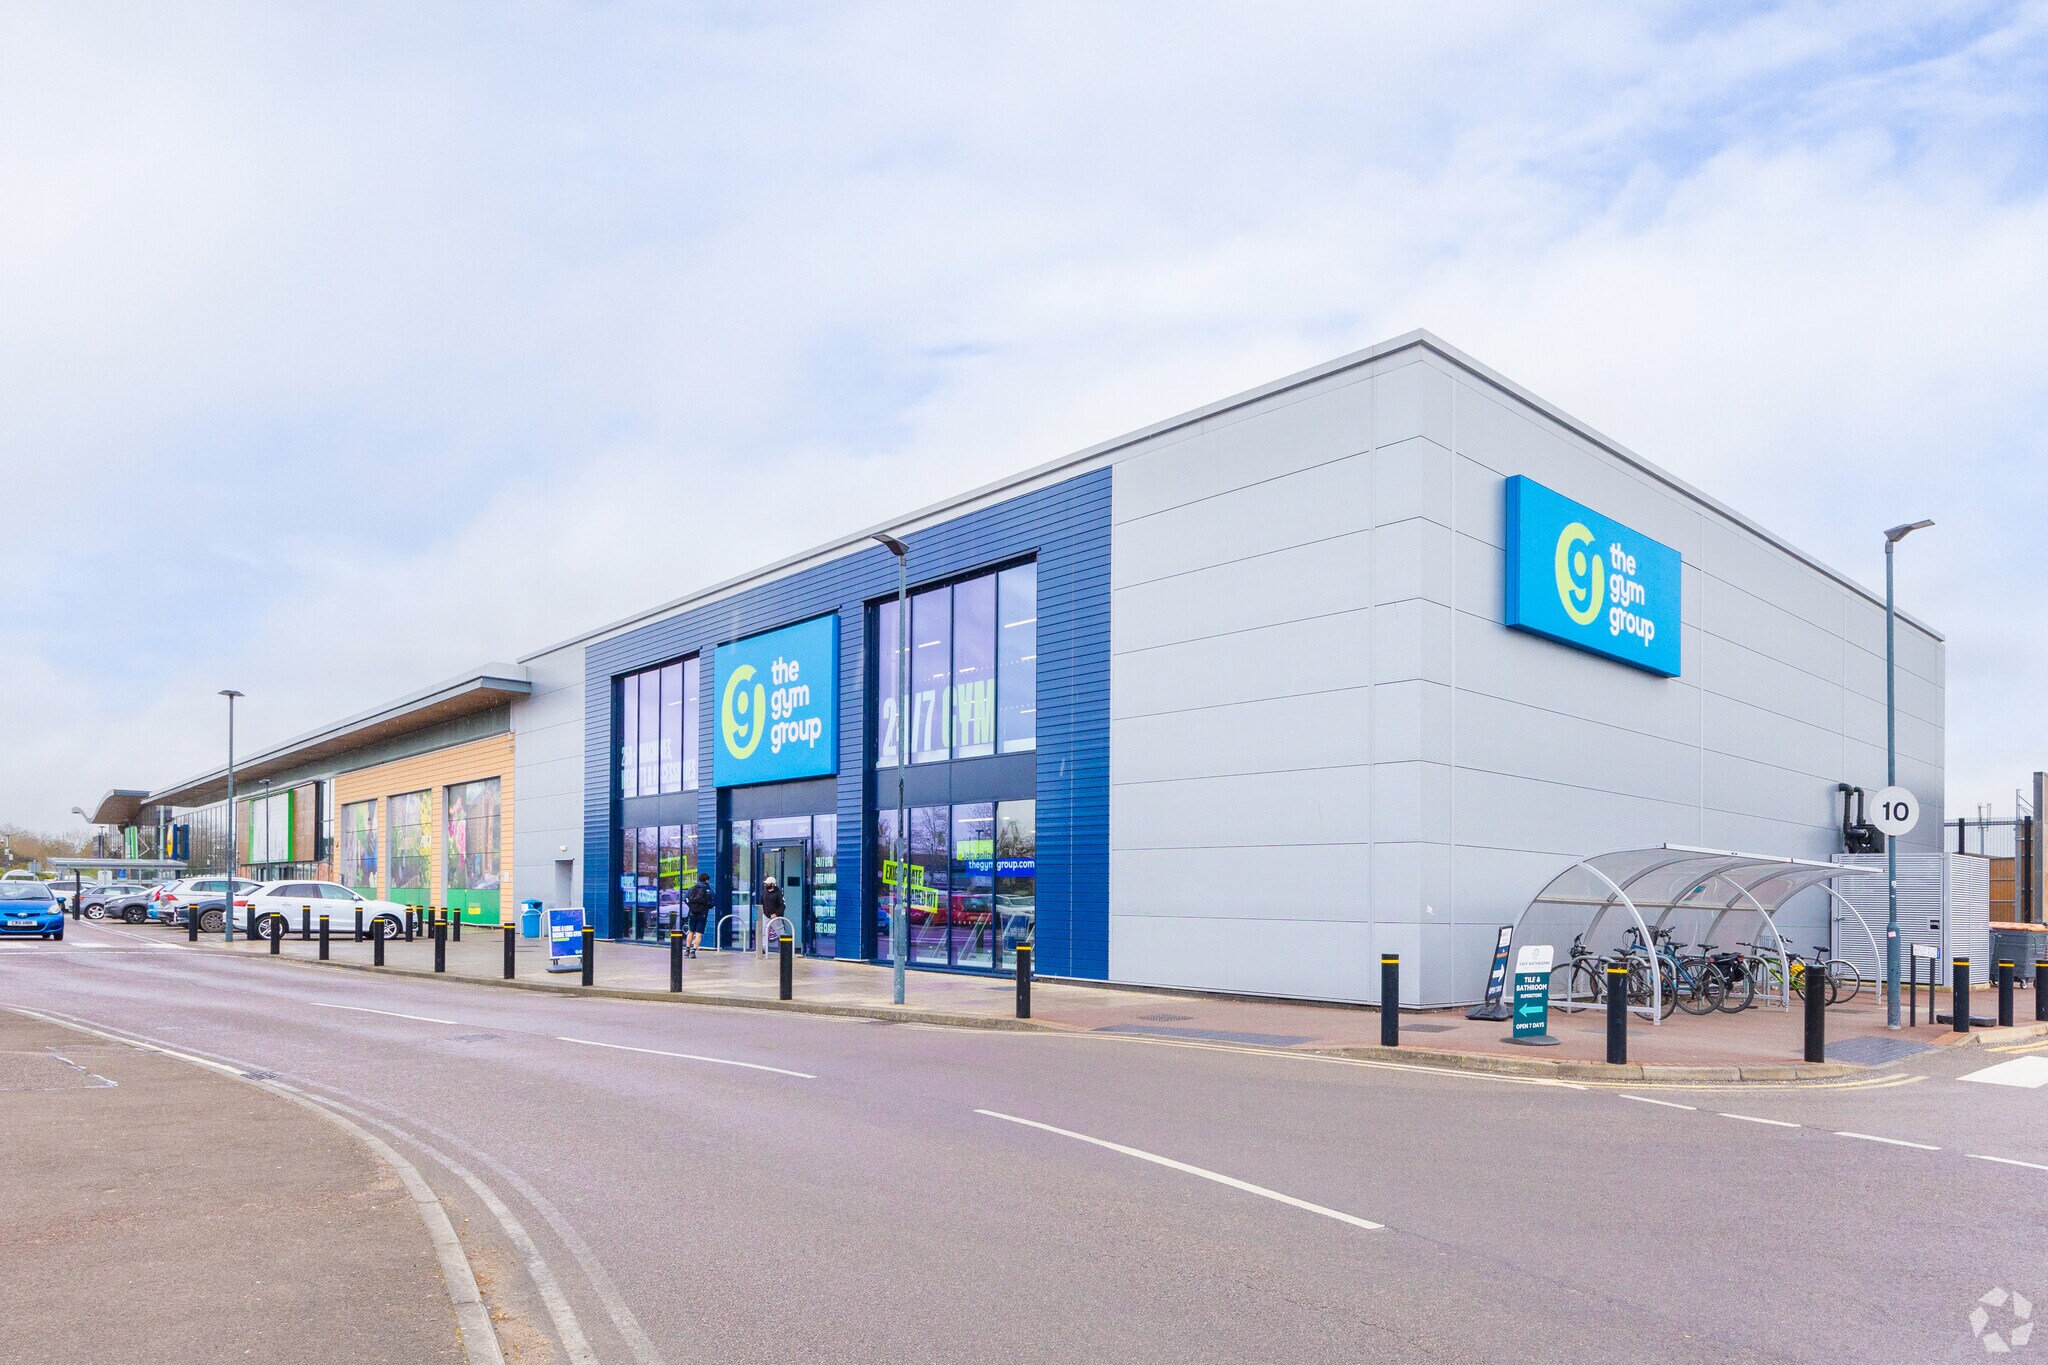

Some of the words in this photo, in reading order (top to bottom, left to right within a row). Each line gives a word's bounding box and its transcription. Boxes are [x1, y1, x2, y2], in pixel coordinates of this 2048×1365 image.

[1610, 543, 1636, 576] the
[1610, 573, 1645, 607] gym
[1610, 606, 1655, 647] group
[771, 656, 800, 685] the
[771, 684, 810, 720] gym
[942, 678, 995, 749] GYM
[770, 717, 822, 753] group
[1882, 801, 1909, 822] 10
[976, 850, 993, 860] onlin
[1516, 983, 1547, 991] BATHROOM
[1532, 1021, 1545, 1029] DAYS
